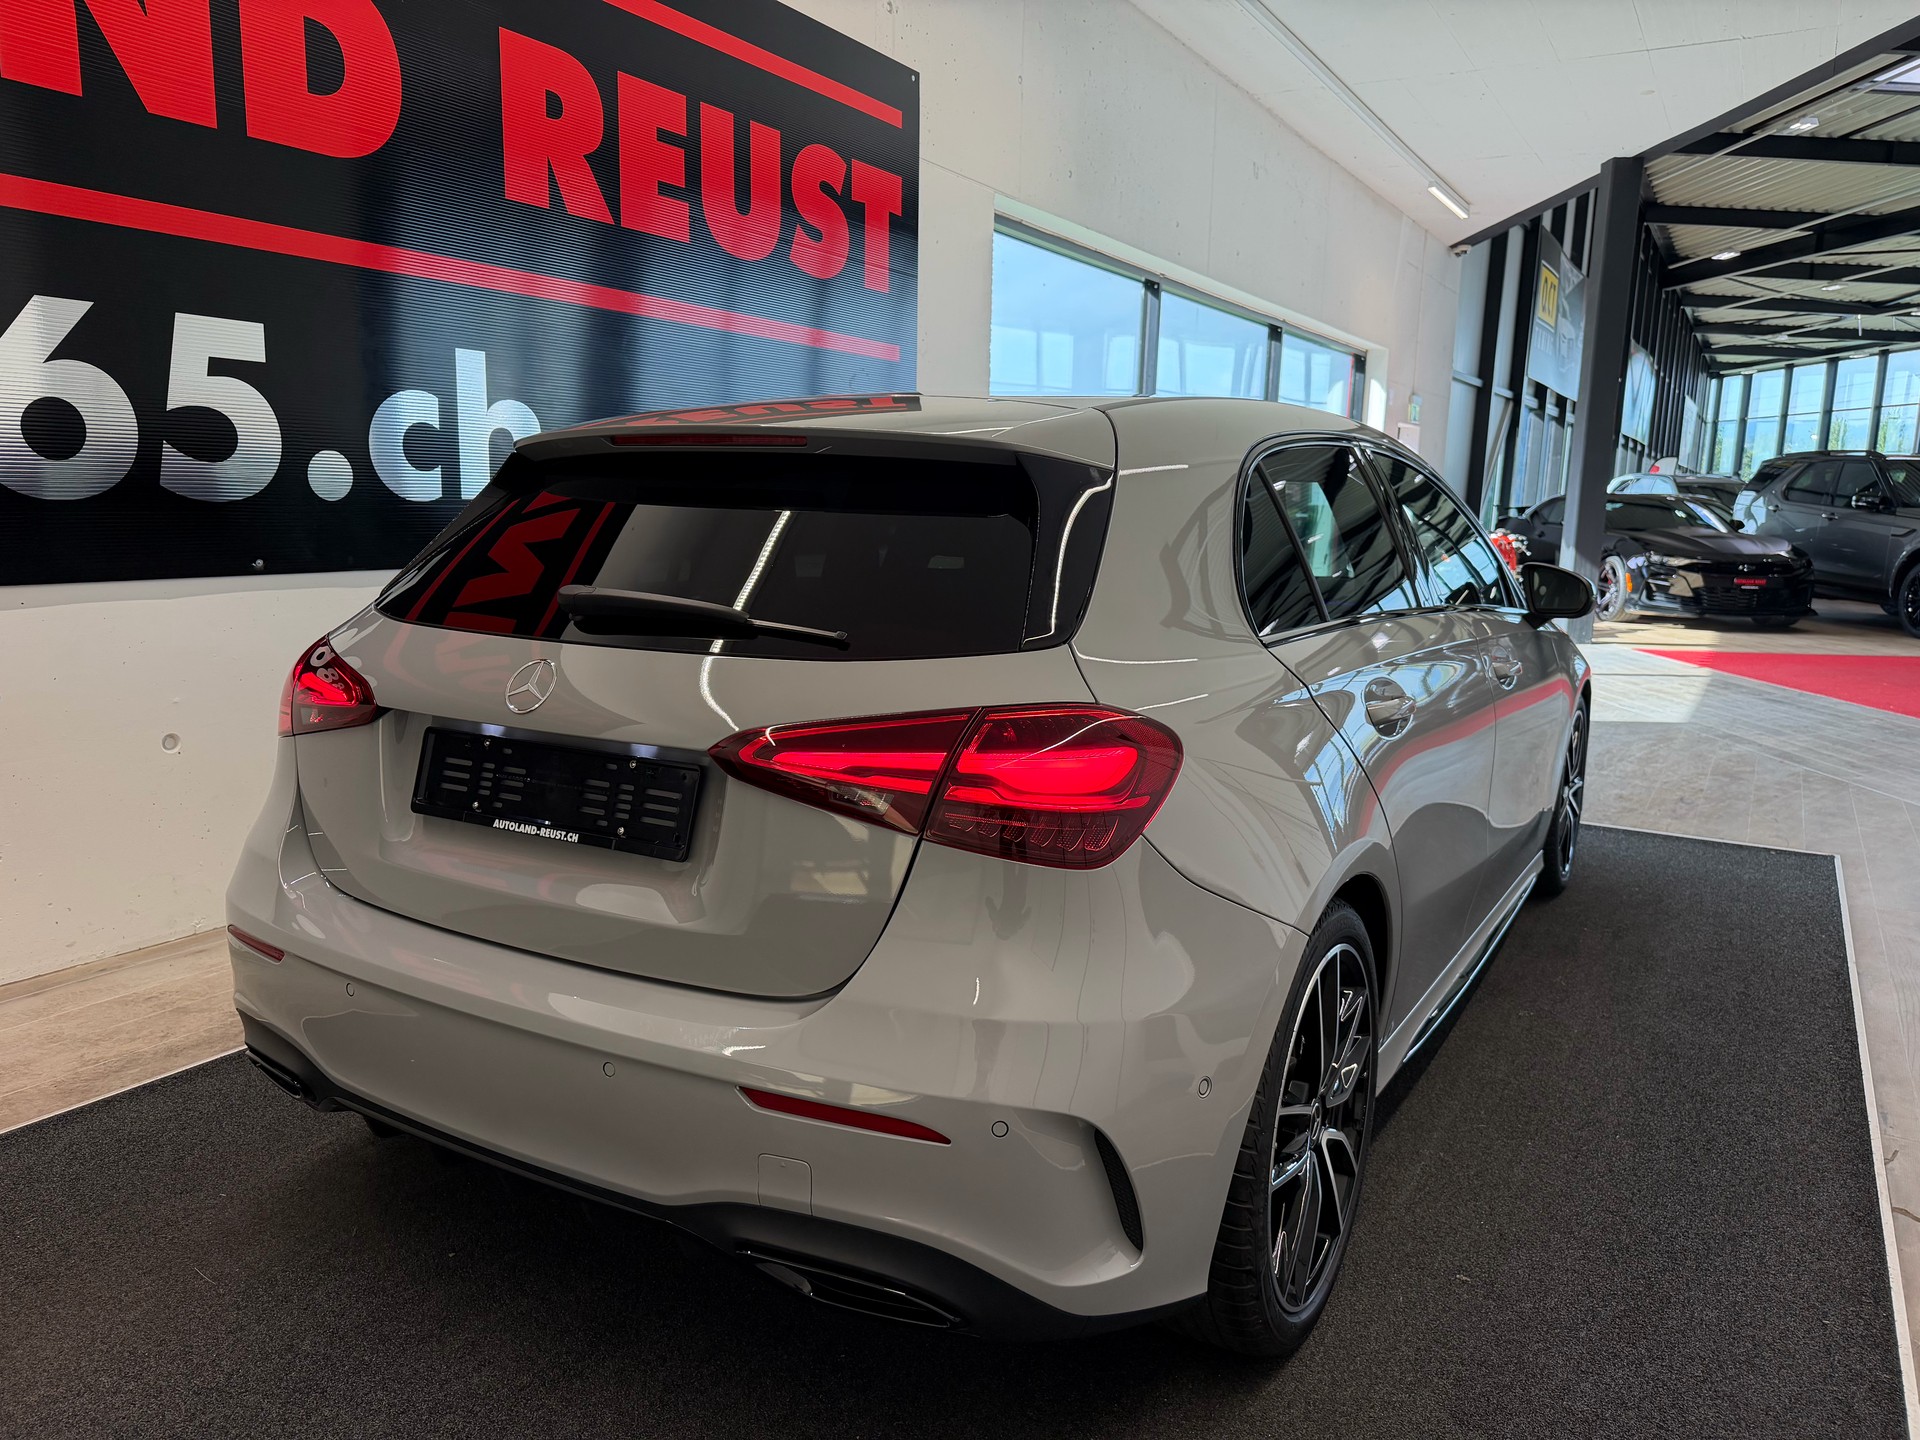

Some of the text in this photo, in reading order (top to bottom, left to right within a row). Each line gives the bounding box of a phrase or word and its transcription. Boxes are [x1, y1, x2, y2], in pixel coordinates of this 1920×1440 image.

[499, 27, 903, 293] REUST
[0, 294, 542, 502] 65.ch
[493, 819, 579, 843] AUTOLAND-REUST.CH
